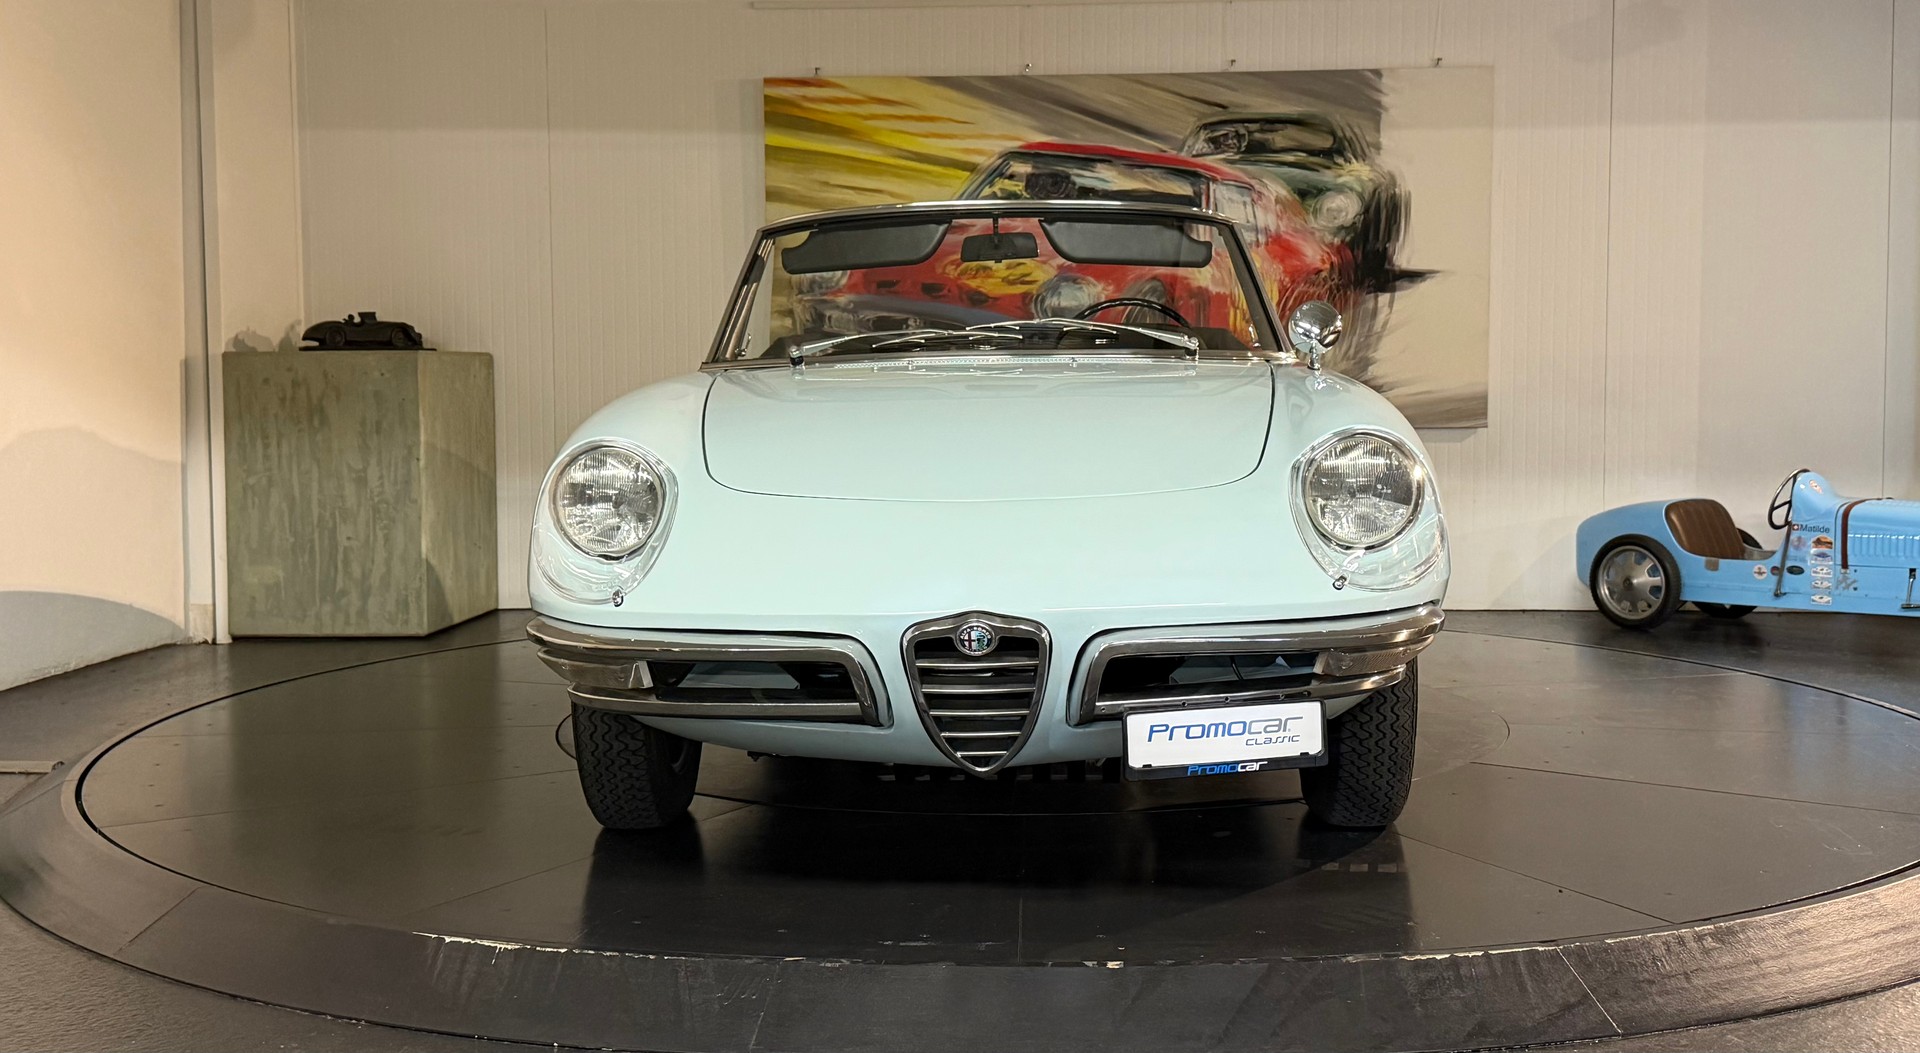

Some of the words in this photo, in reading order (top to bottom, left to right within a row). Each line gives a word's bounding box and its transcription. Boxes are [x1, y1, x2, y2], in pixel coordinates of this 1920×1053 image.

[1800, 523, 1830, 533] Matilde
[1147, 716, 1303, 742] Promocar
[1187, 761, 1268, 776] Promocar
